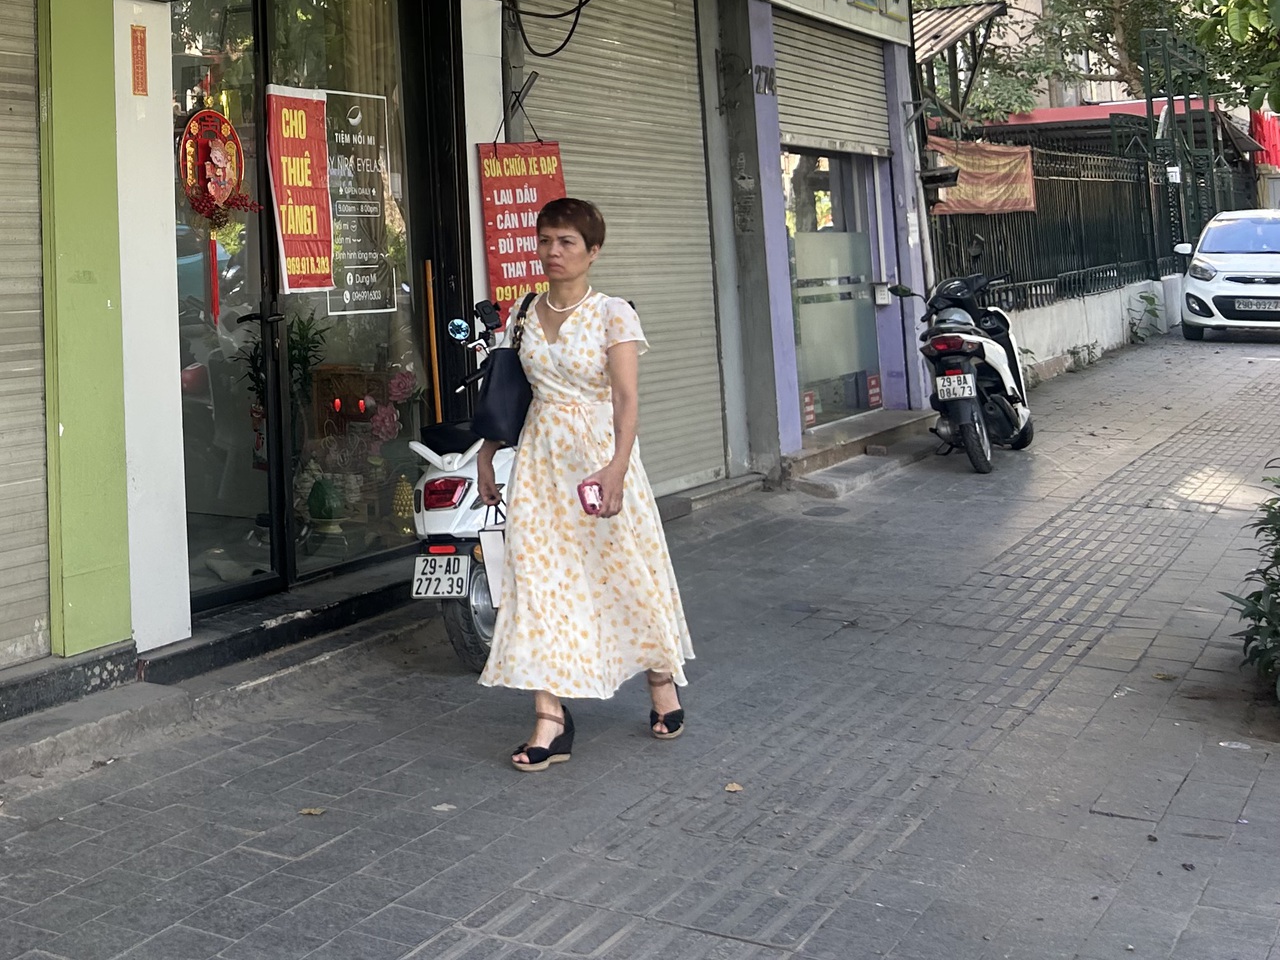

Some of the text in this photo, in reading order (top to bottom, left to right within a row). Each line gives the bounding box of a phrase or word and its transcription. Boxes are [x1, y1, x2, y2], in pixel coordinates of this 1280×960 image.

[281, 107, 307, 140] CHO
[335, 130, 375, 146] TIỆM NỐI MI
[280, 150, 312, 187] THUÊ
[483, 152, 558, 179] SỬA CHỮA XE ĐẠP
[493, 188, 514, 206] LAU
[496, 210, 519, 230] CÂN
[498, 232, 514, 255] ĐỦ
[516, 235, 538, 255] PHỤ
[501, 259, 544, 279] THAY TH
[421, 557, 461, 576] 29-AD
[414, 577, 464, 596] 272.39
